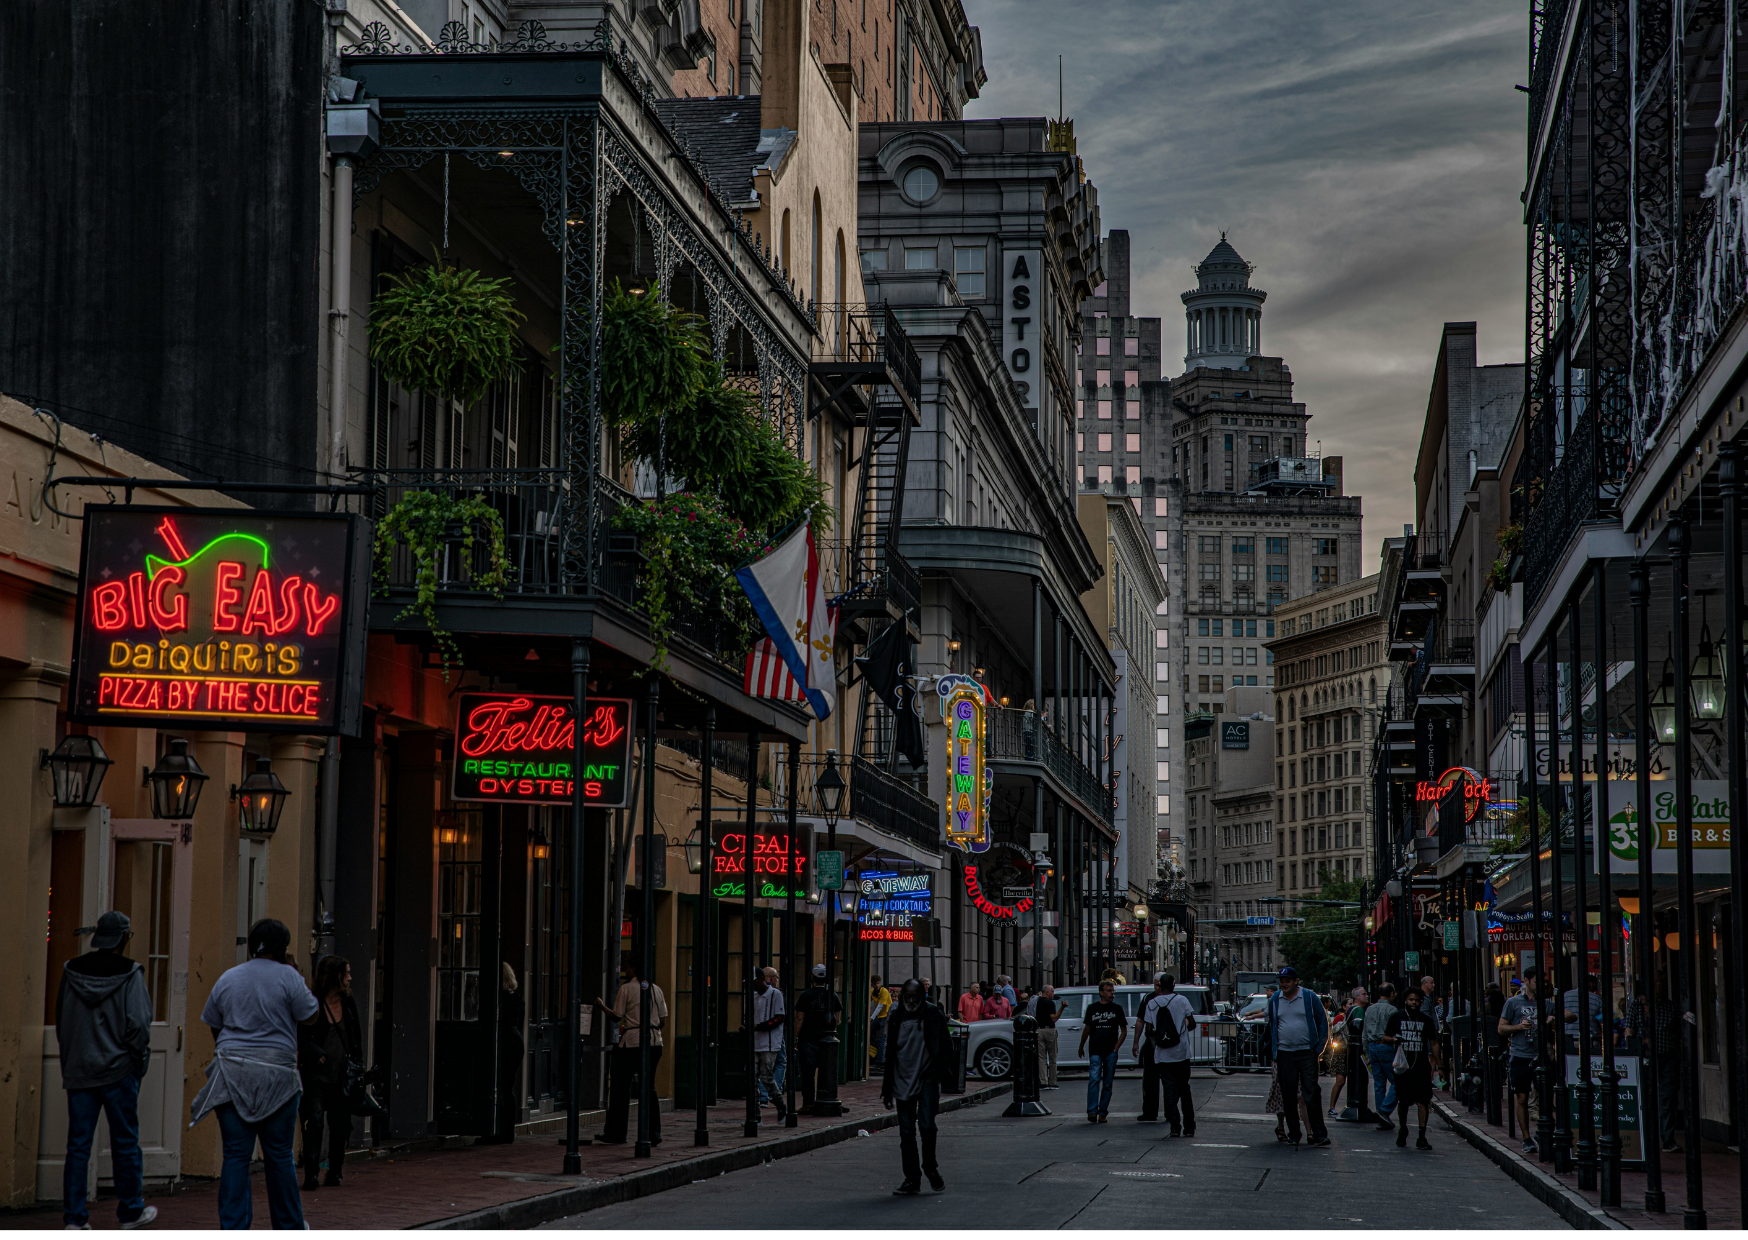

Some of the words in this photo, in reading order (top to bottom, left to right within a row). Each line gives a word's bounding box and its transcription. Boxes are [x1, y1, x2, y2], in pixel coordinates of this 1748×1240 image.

[1011, 255, 1031, 404] ASTOR
[93, 564, 189, 631] BIG
[214, 561, 340, 637] EASY
[99, 677, 160, 709] PIZZA
[168, 681, 199, 711] BY
[204, 681, 249, 712] THE
[252, 683, 319, 716] SLICE
[461, 697, 625, 757] Felix's
[1226, 725, 1246, 736] AC
[955, 701, 974, 830] GATEWAY
[1427, 743, 1441, 781] CENTR
[464, 759, 619, 780] RESTAURNT
[1415, 779, 1454, 801] Hard
[1463, 777, 1492, 802] ock
[1666, 828, 1703, 842] BR
[1705, 828, 1719, 842] &
[761, 883, 806, 897] Orlens
[964, 865, 1014, 919] BOURBON
[890, 899, 931, 912] COCKTAILS
[898, 914, 923, 927] BE
[986, 917, 1018, 928] SEAFOO
[1505, 922, 1552, 932] AUTHEIC
[860, 930, 884, 940] ACOS
[885, 929, 892, 940] &
[893, 930, 914, 940] BURR
[1488, 933, 1501, 942] EW
[1502, 932, 1535, 942] ORLEAN
[1543, 931, 1576, 941] CUINE
[1400, 1020, 1425, 1032] AWW
